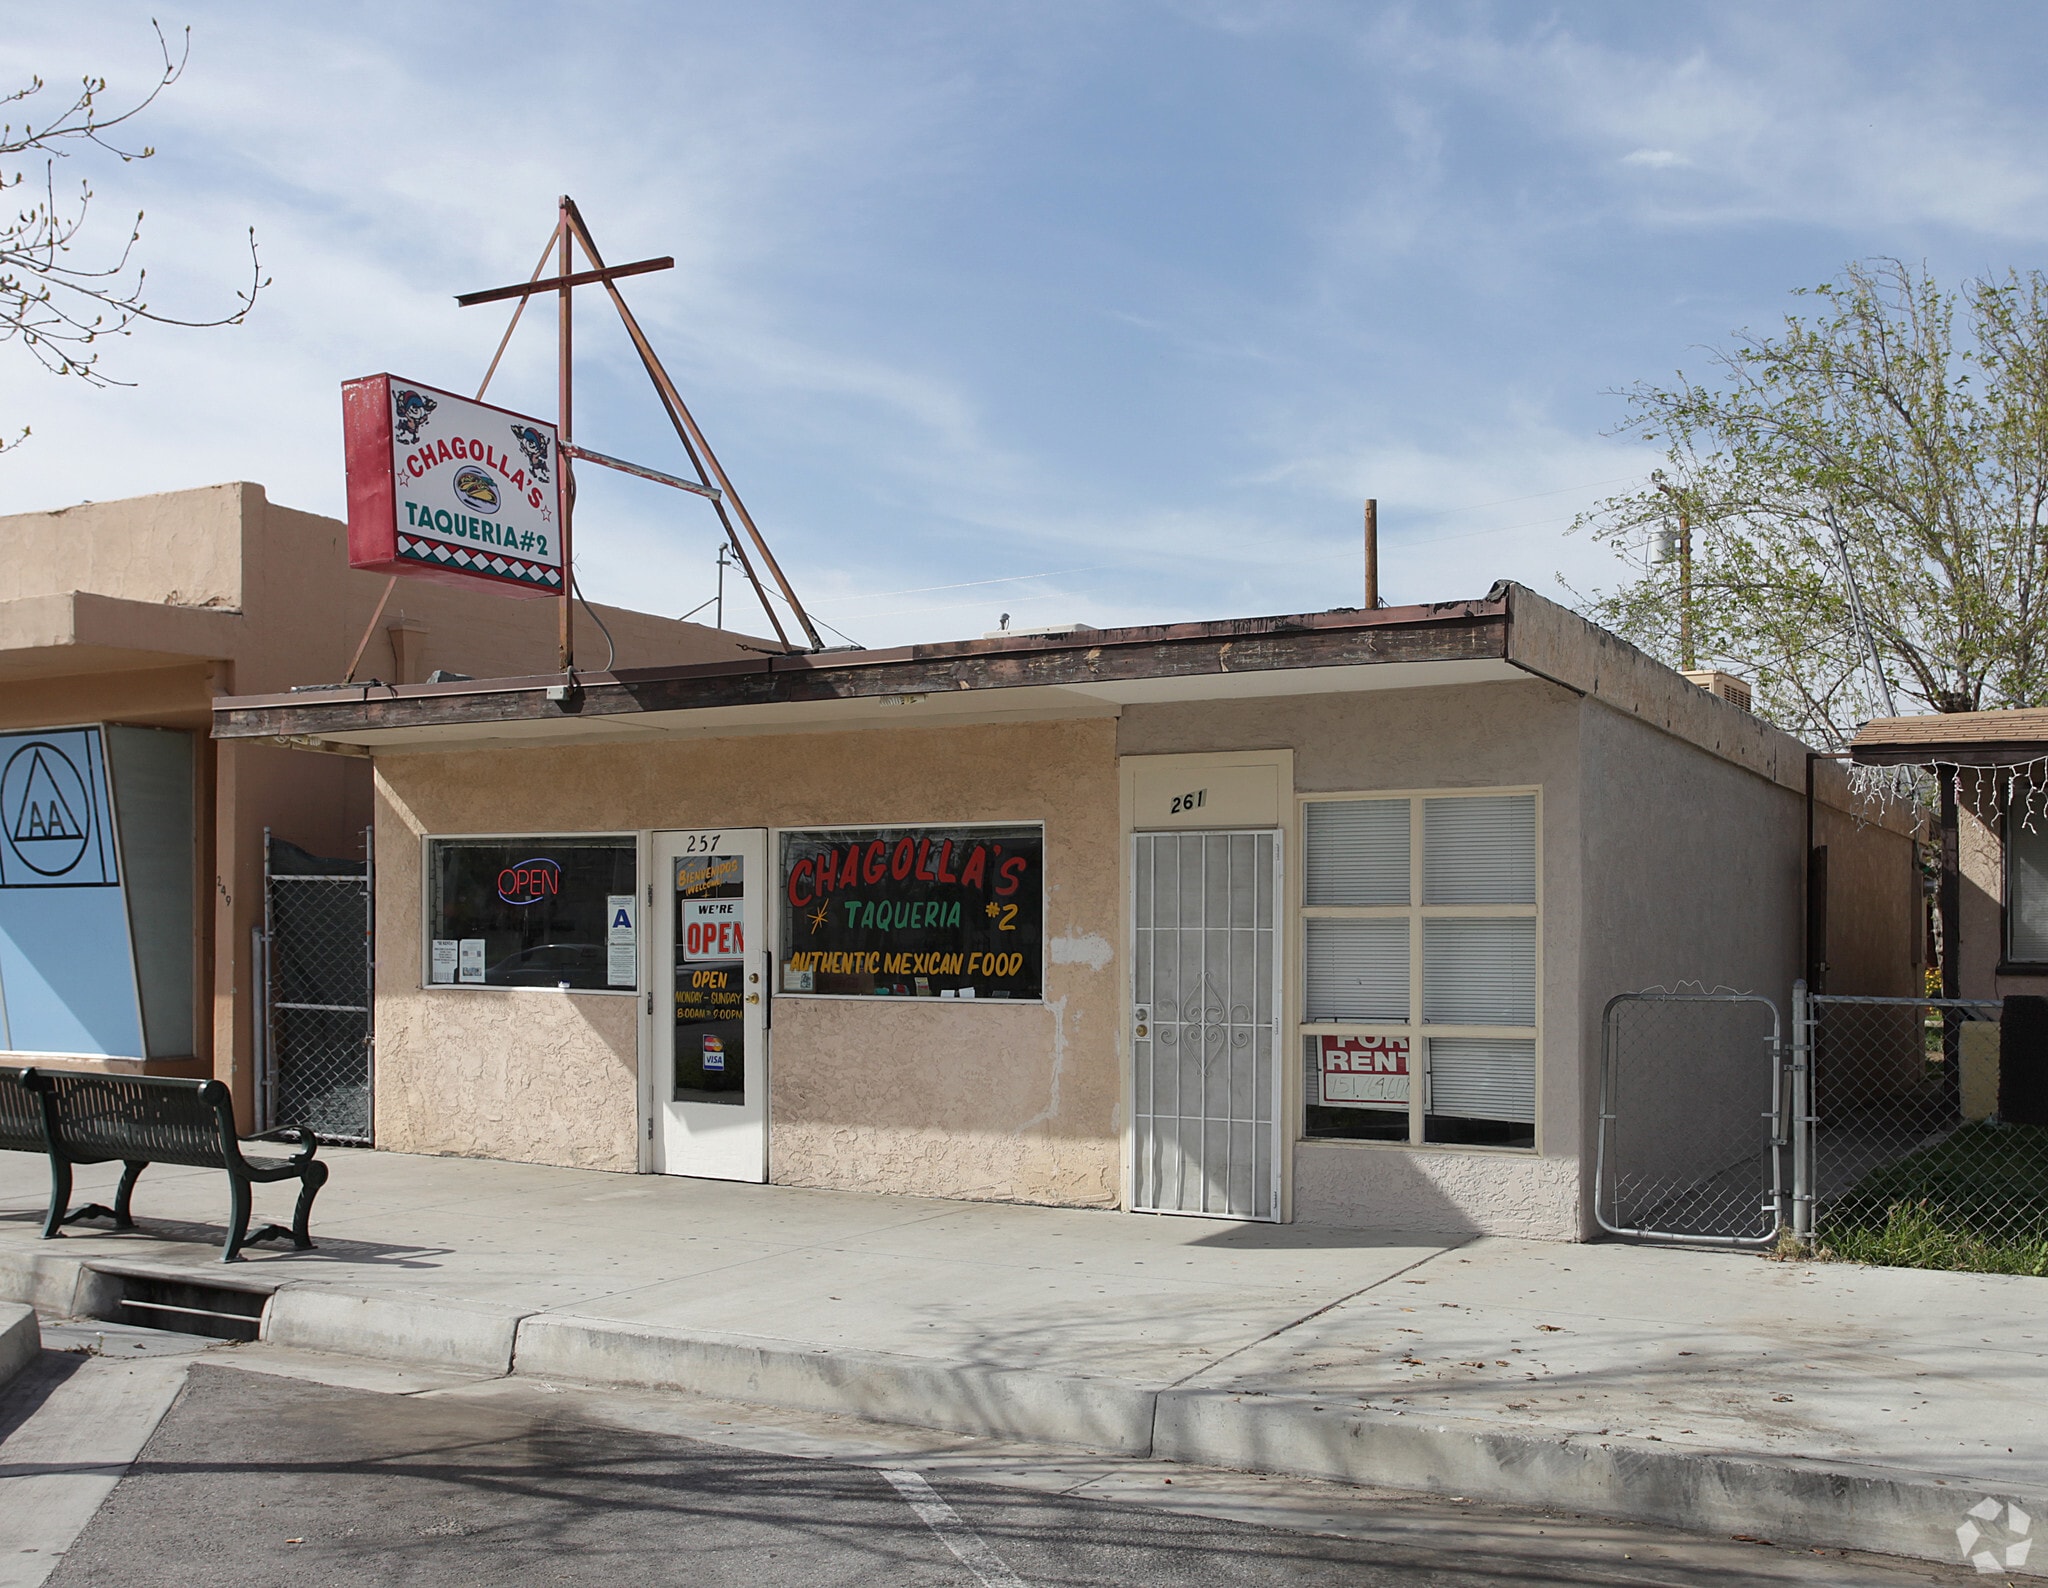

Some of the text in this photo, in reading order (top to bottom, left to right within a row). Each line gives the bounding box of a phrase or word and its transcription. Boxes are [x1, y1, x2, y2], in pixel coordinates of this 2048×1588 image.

[406, 436, 544, 509] CHAGOLLA'S
[1171, 790, 1203, 814] 261
[30, 800, 67, 837] AA
[687, 834, 721, 853] 257
[497, 868, 559, 895] OPEN
[677, 859, 739, 888] BIENVENIDOS
[787, 837, 1027, 907] CHAGOLLA'S
[217, 875, 232, 907] 249
[612, 908, 632, 928] A
[698, 904, 734, 915] WE'RE
[844, 900, 1019, 932] TAQUERIA #2
[687, 921, 744, 955] OPEN
[789, 951, 1024, 977] AUTHENTIC MEXICAN FOOD
[692, 970, 728, 989] OPEN
[675, 991, 704, 1004] MONDAY
[710, 992, 742, 1005] SUNDAY
[1336, 1035, 1408, 1049] FOR
[706, 1055, 722, 1064] VISA
